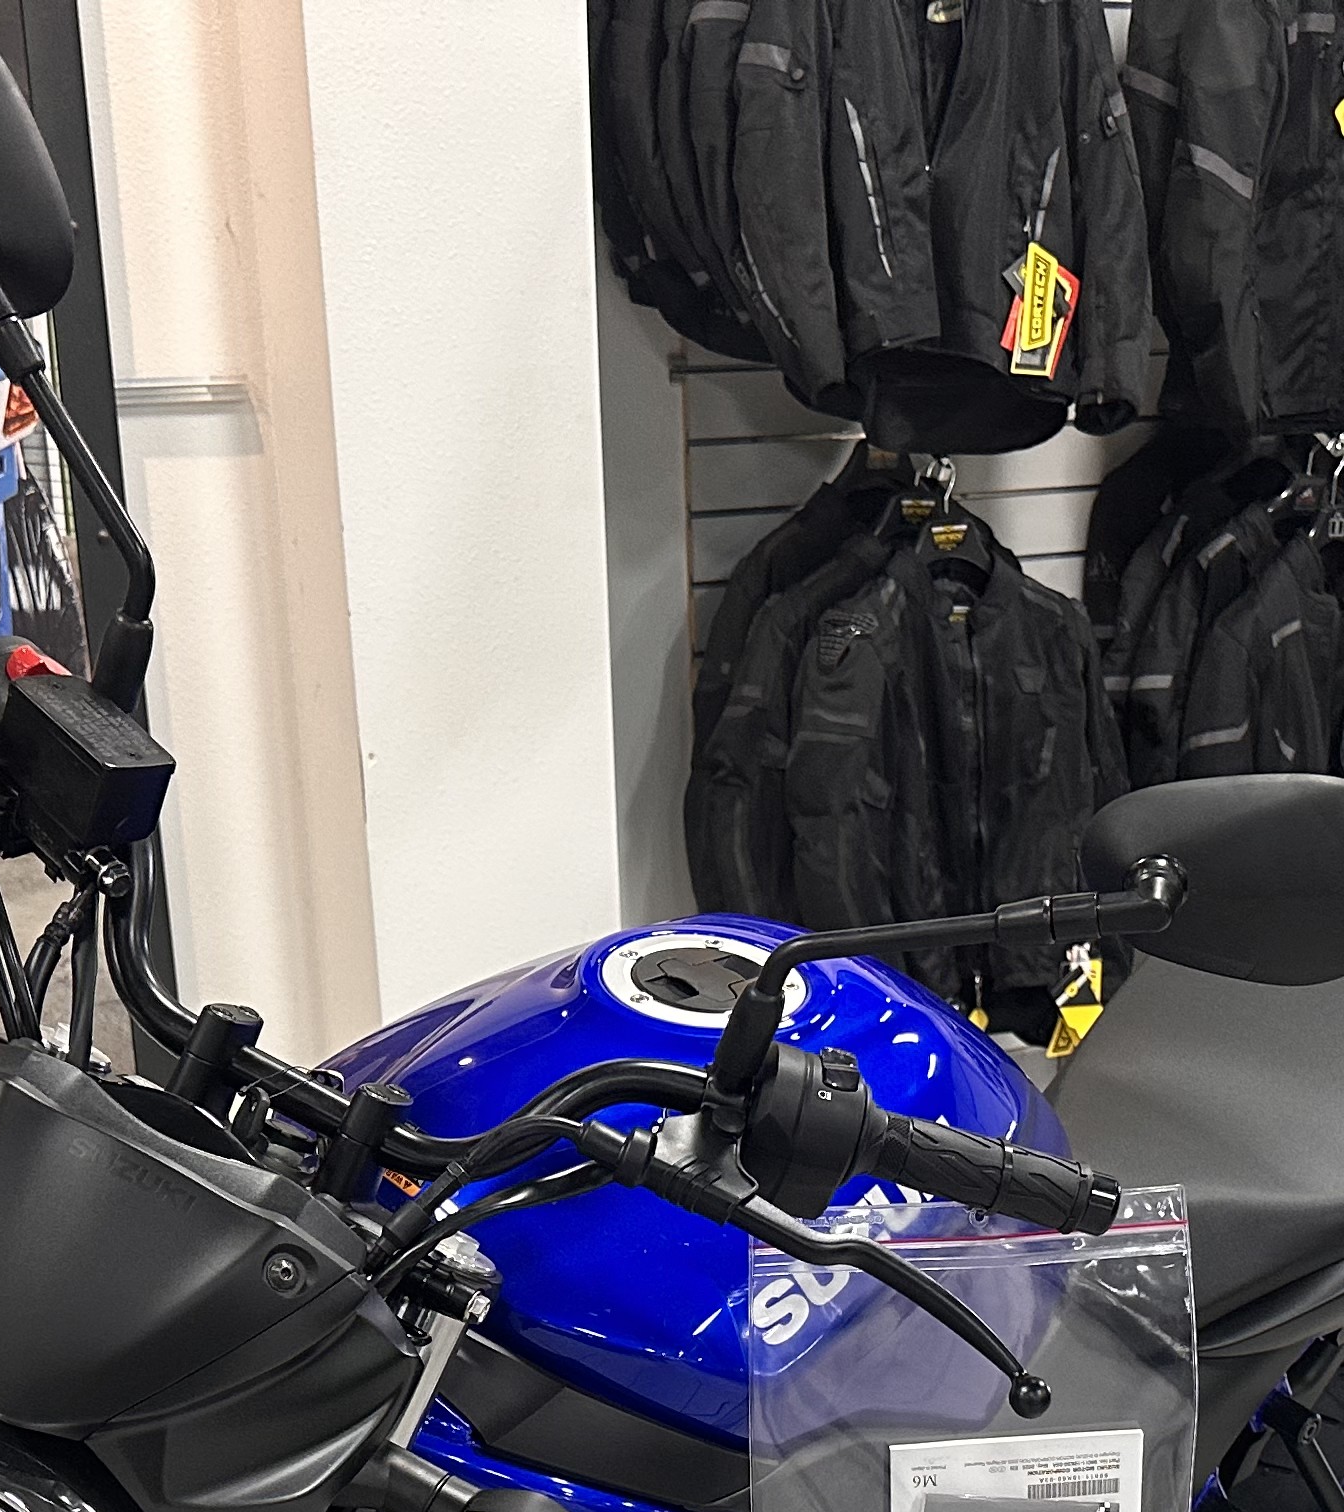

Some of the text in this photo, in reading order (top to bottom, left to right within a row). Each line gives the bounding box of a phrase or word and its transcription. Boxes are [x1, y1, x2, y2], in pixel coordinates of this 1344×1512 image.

[1031, 260, 1050, 341] CORTECH
[68, 1137, 198, 1214] SUZUKI
[912, 1474, 938, 1488] M6
